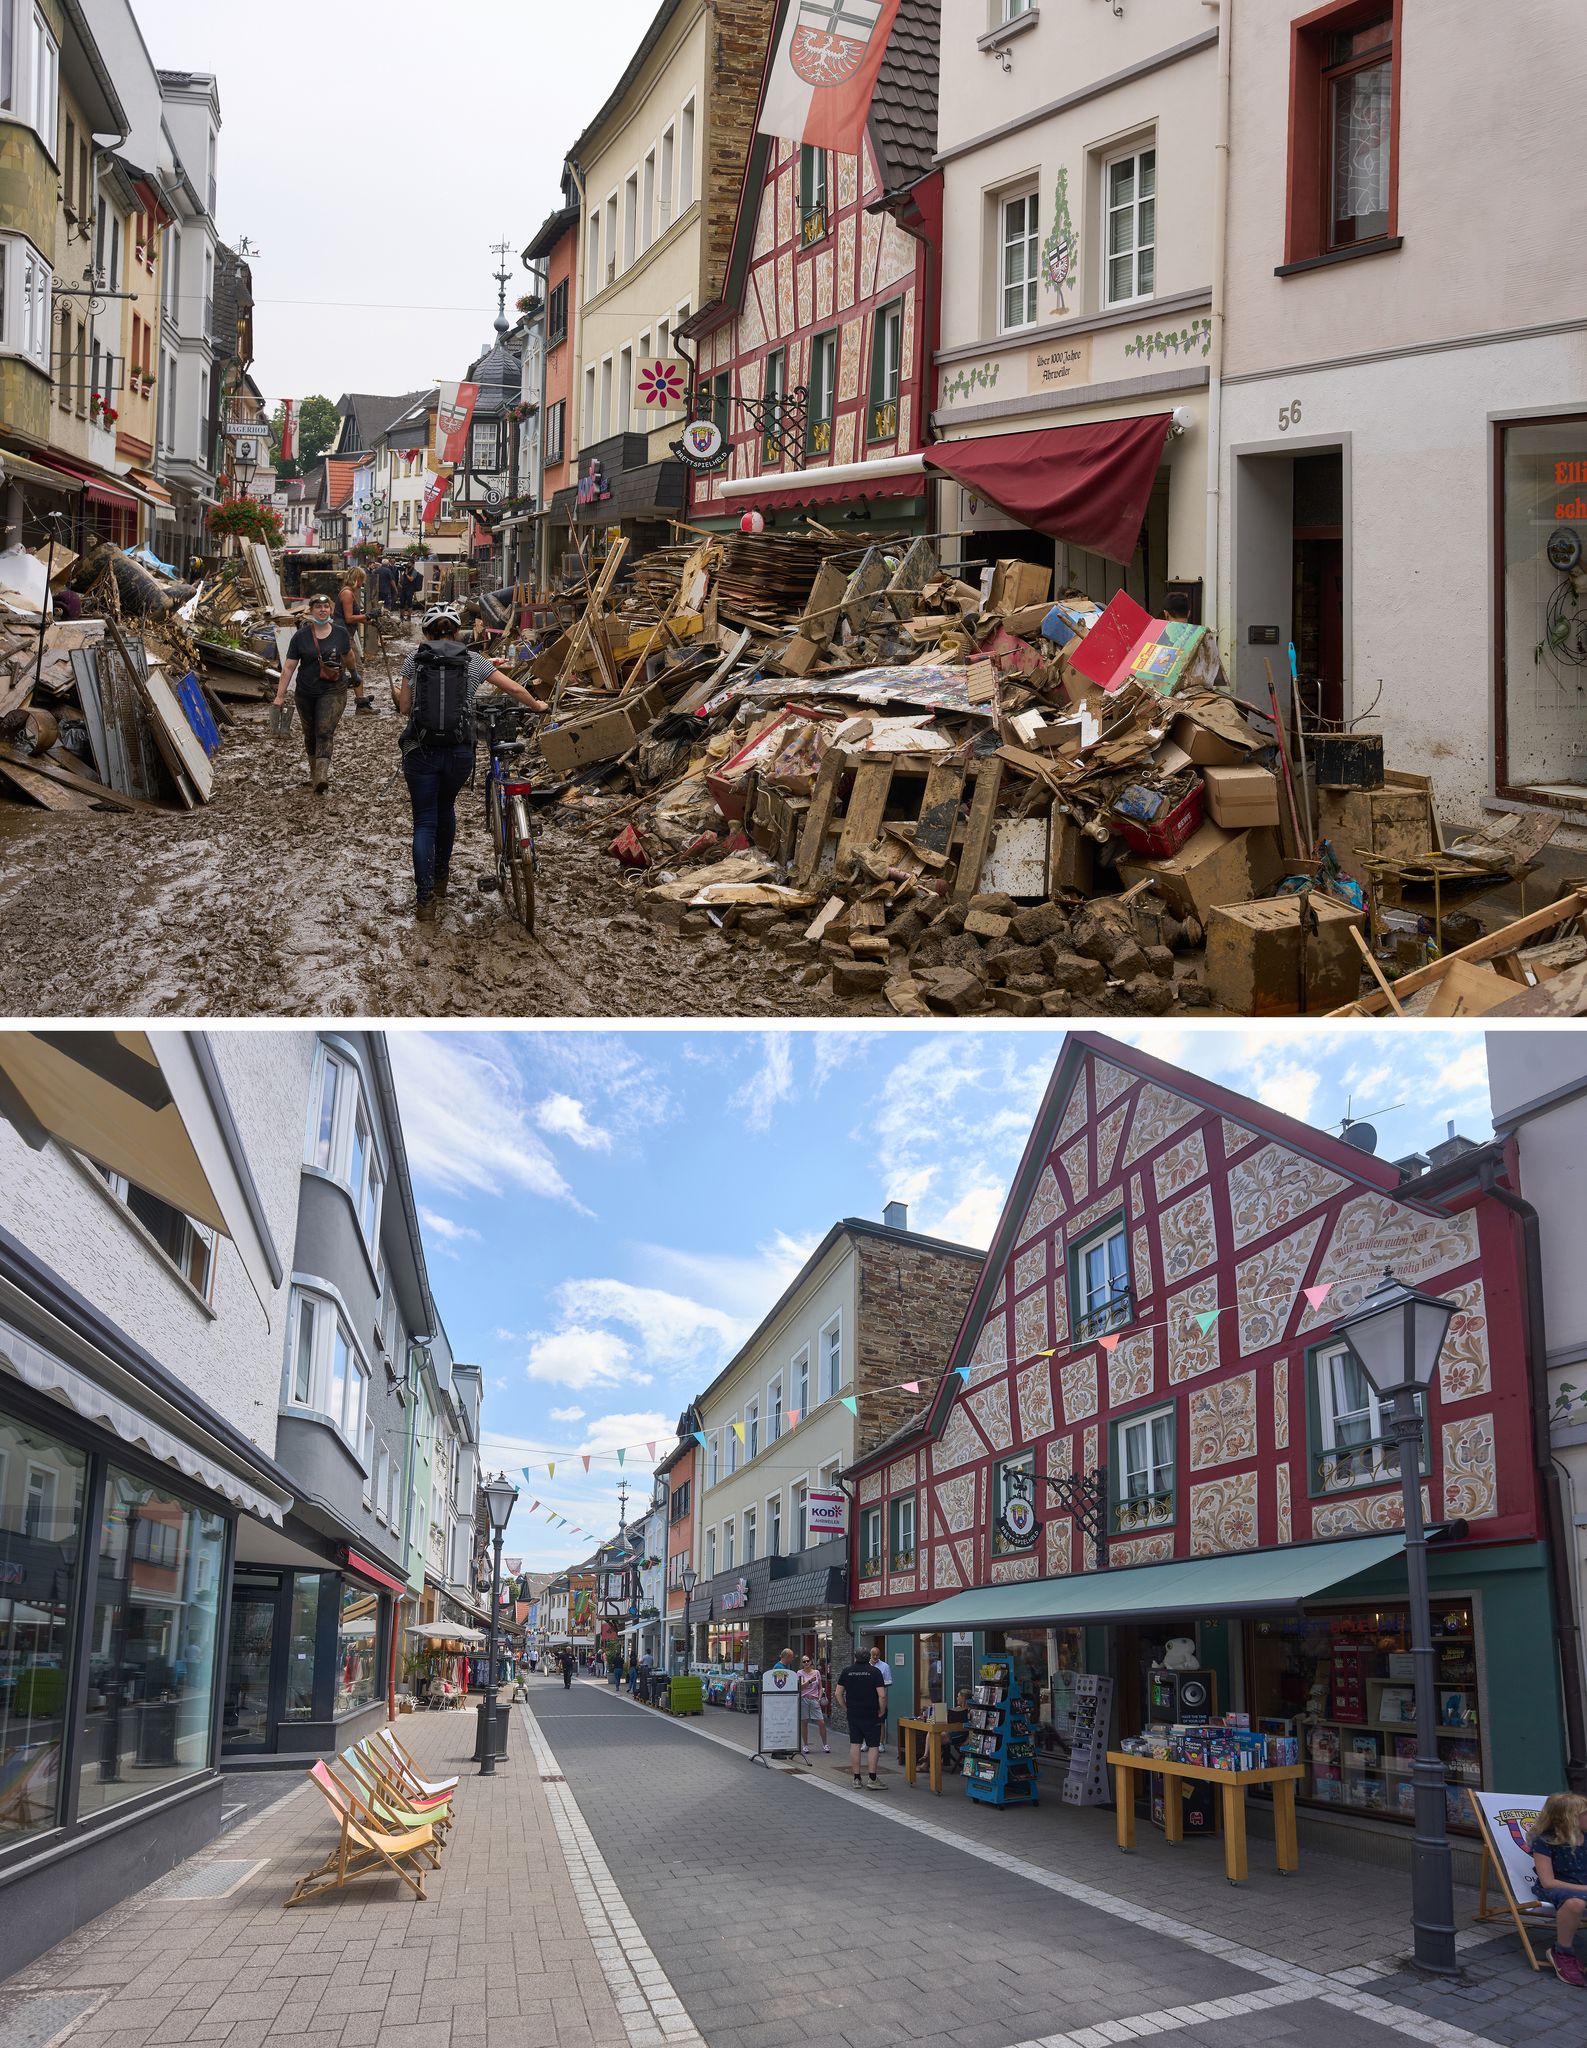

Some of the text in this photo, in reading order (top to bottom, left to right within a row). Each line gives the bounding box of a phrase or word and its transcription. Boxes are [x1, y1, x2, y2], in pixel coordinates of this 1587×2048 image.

[1063, 350, 1081, 365] Jahre
[1041, 366, 1071, 384] Ahrweiler
[1278, 399, 1302, 431] 56
[675, 450, 728, 468] BRETTSPIELHELD
[1385, 1234, 1409, 1249] guten
[1410, 1230, 1429, 1244] Rat
[1397, 1261, 1420, 1275] nötig
[1000, 1525, 1039, 1546] BRETTSPIELHELD
